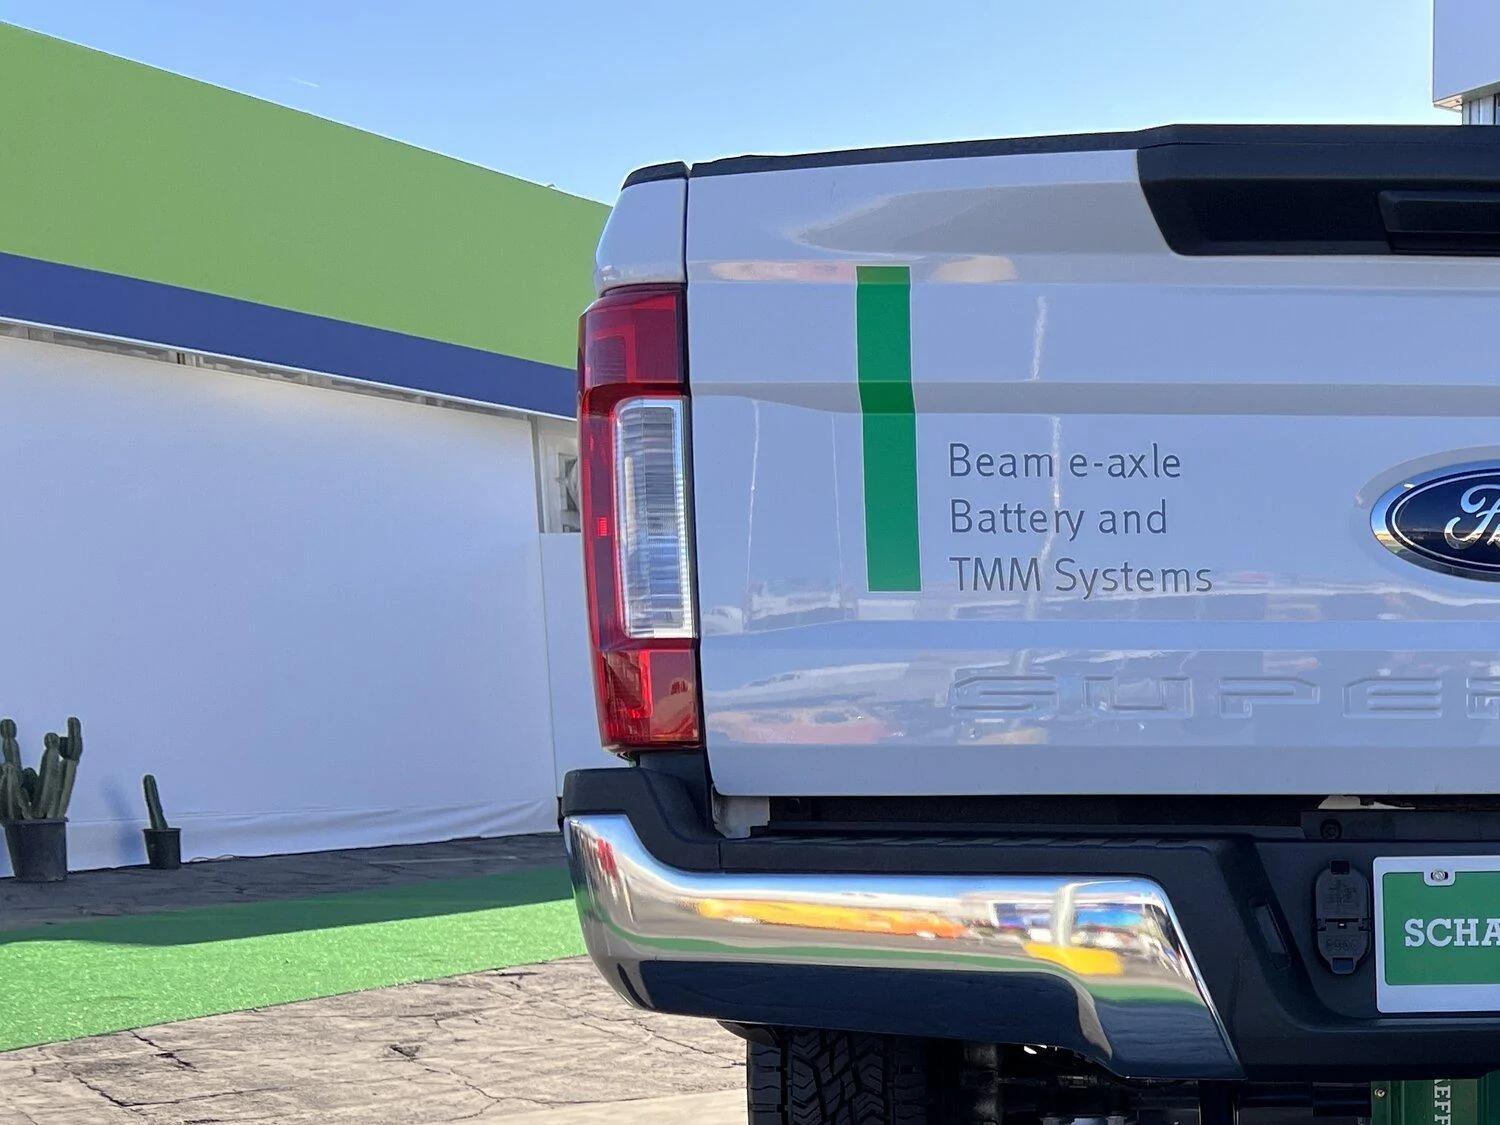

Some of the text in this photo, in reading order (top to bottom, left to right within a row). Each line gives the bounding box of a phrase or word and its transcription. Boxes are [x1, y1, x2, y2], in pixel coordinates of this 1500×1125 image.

[948, 442, 1182, 479] Beam e-axle
[949, 498, 1168, 542] Battery and
[947, 557, 1214, 600] TMM Systems
